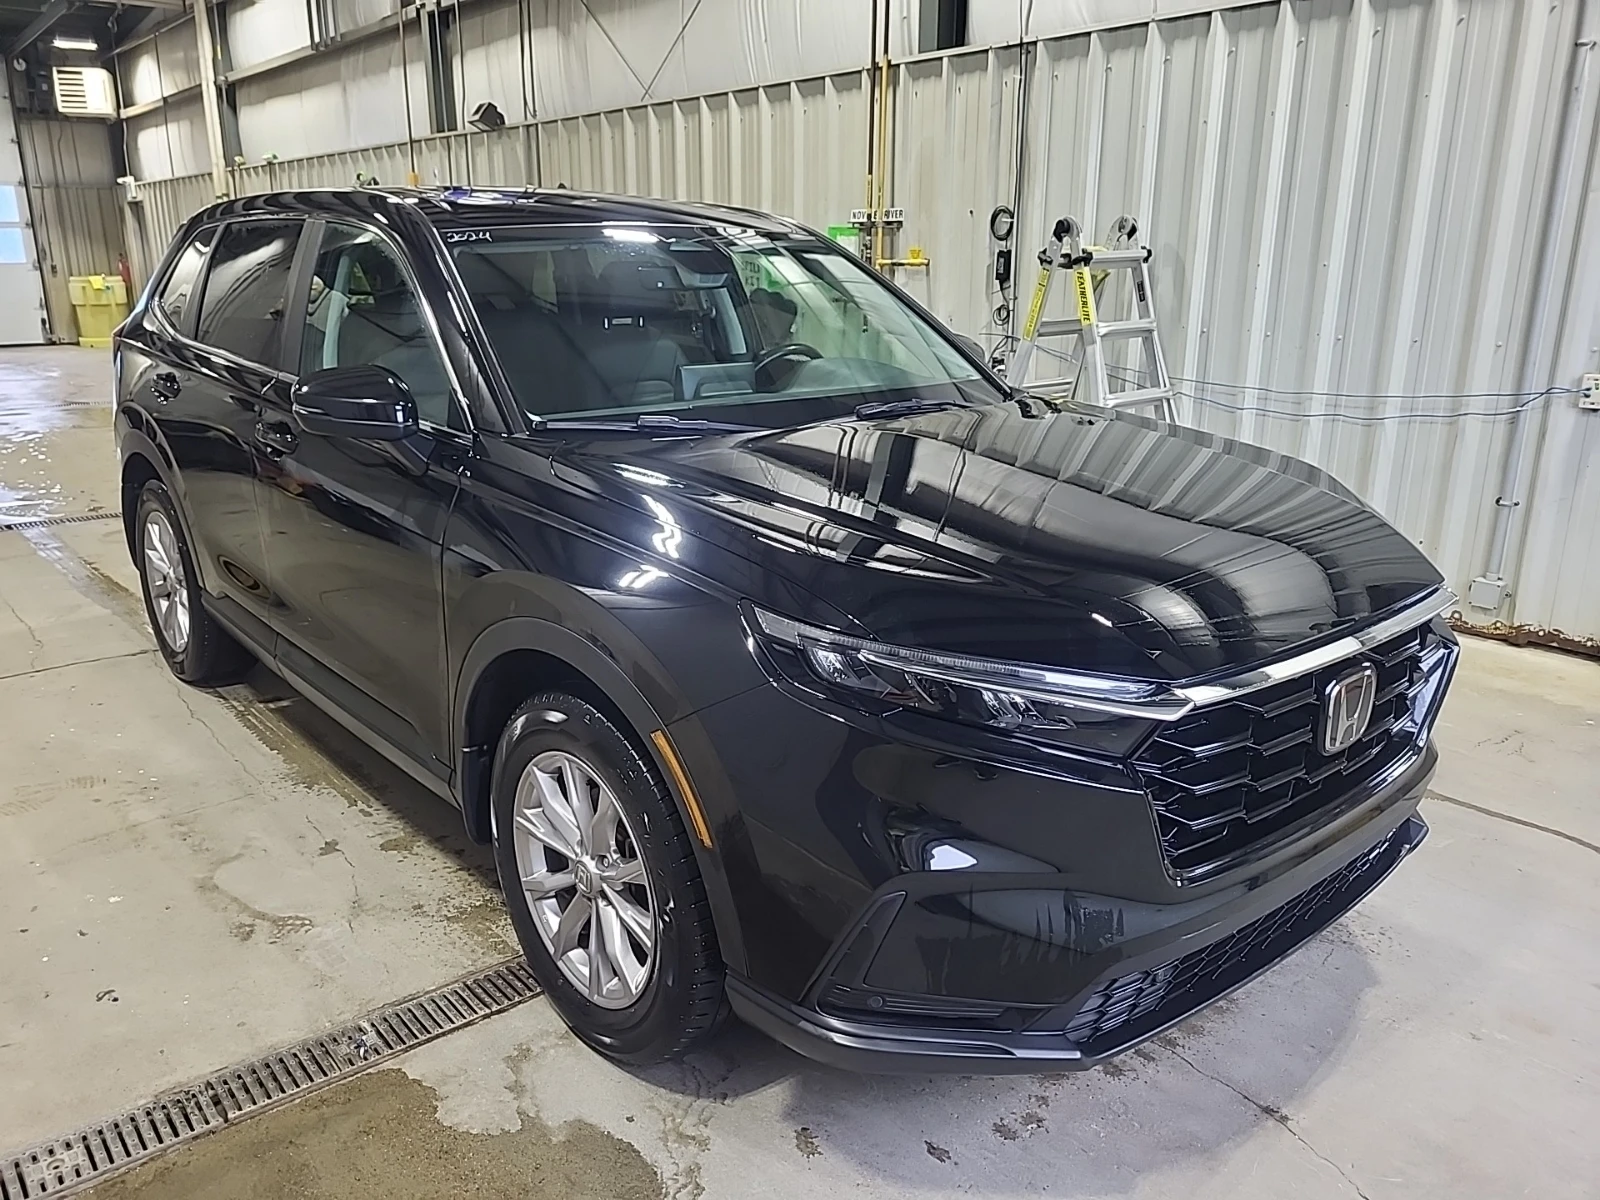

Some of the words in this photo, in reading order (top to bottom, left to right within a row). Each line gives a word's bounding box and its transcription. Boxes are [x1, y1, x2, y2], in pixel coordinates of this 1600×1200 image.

[852, 210, 878, 220] NOVE
[881, 209, 904, 220] RIVER
[447, 231, 492, 242] 2024
[1076, 271, 1091, 323] FEATHERLITE
